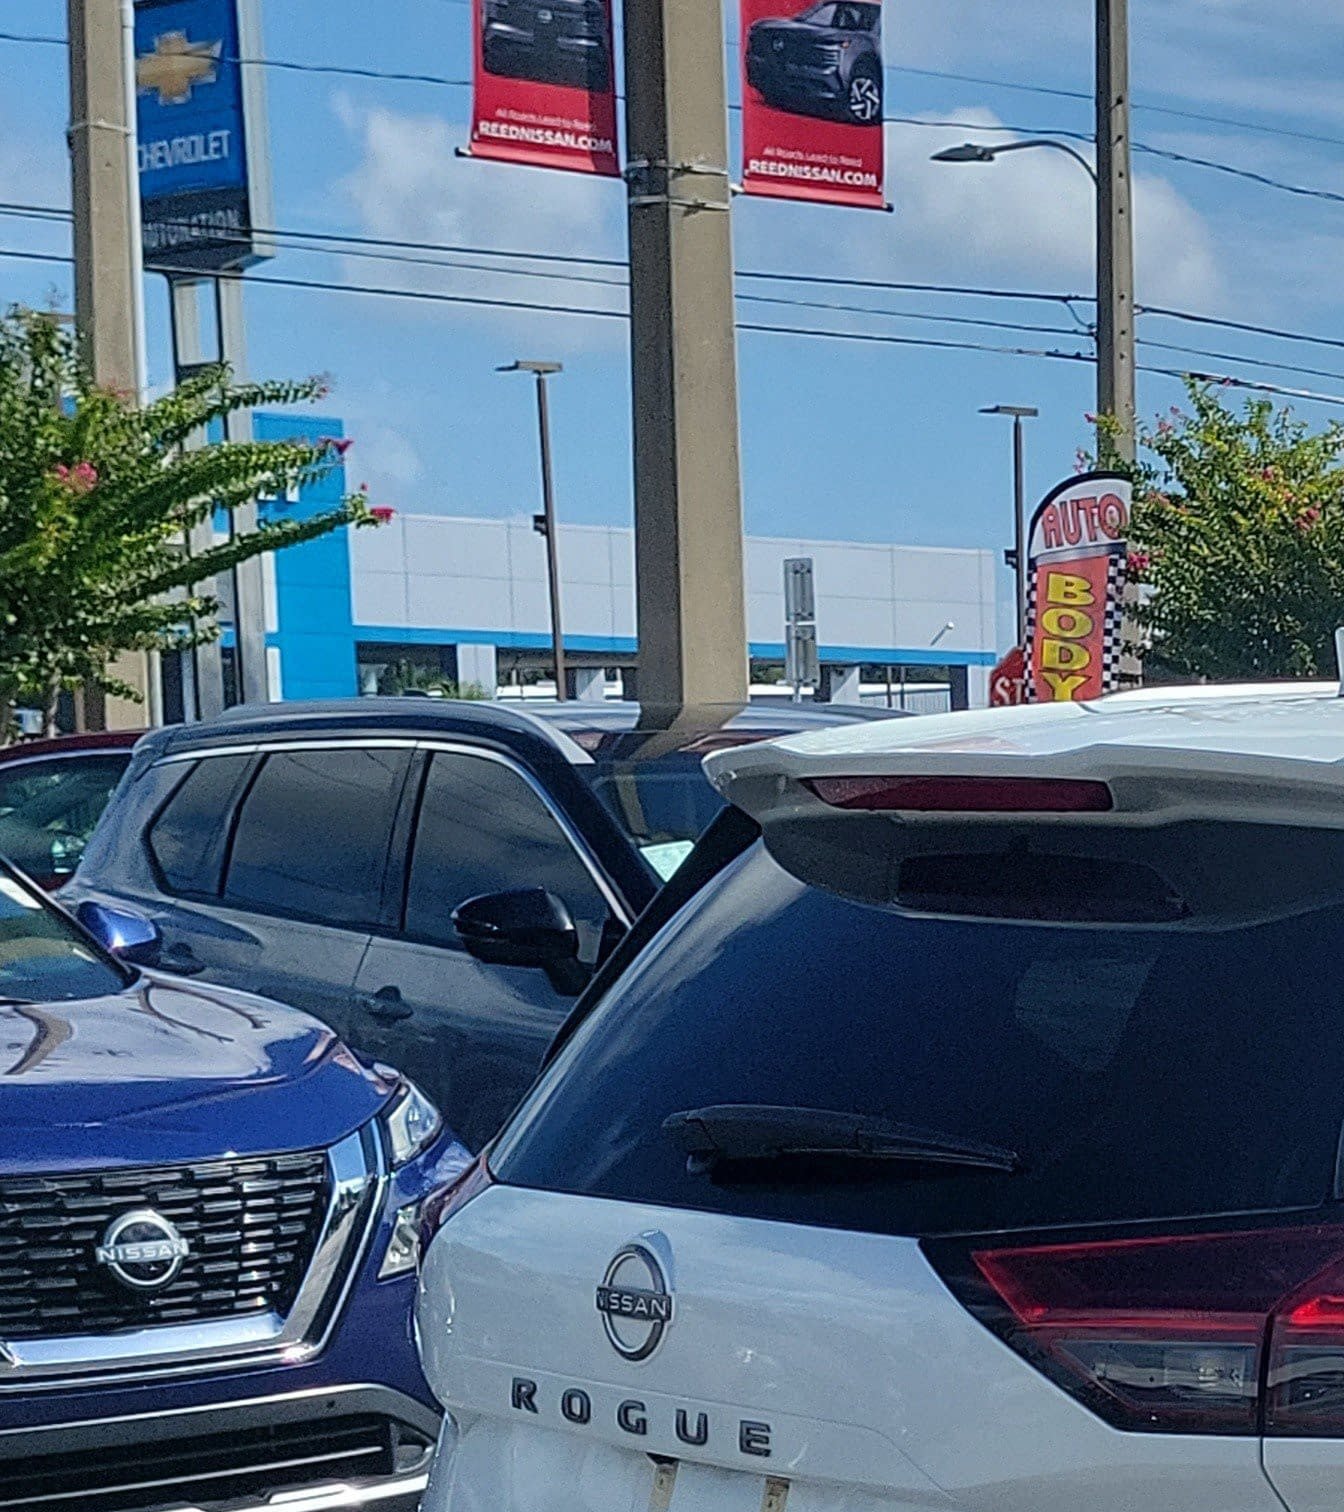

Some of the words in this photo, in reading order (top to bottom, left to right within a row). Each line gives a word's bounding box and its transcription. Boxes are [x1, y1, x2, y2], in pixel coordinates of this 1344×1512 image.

[479, 121, 612, 152] REEDNISSAN.COM
[748, 160, 878, 187] REEDNISSAN.COM
[142, 209, 240, 248] UTONATION
[1040, 492, 1128, 549] AUTO
[1041, 571, 1095, 702] BODY
[98, 1238, 189, 1263] NISSAN
[511, 1376, 773, 1457] ROGUE
